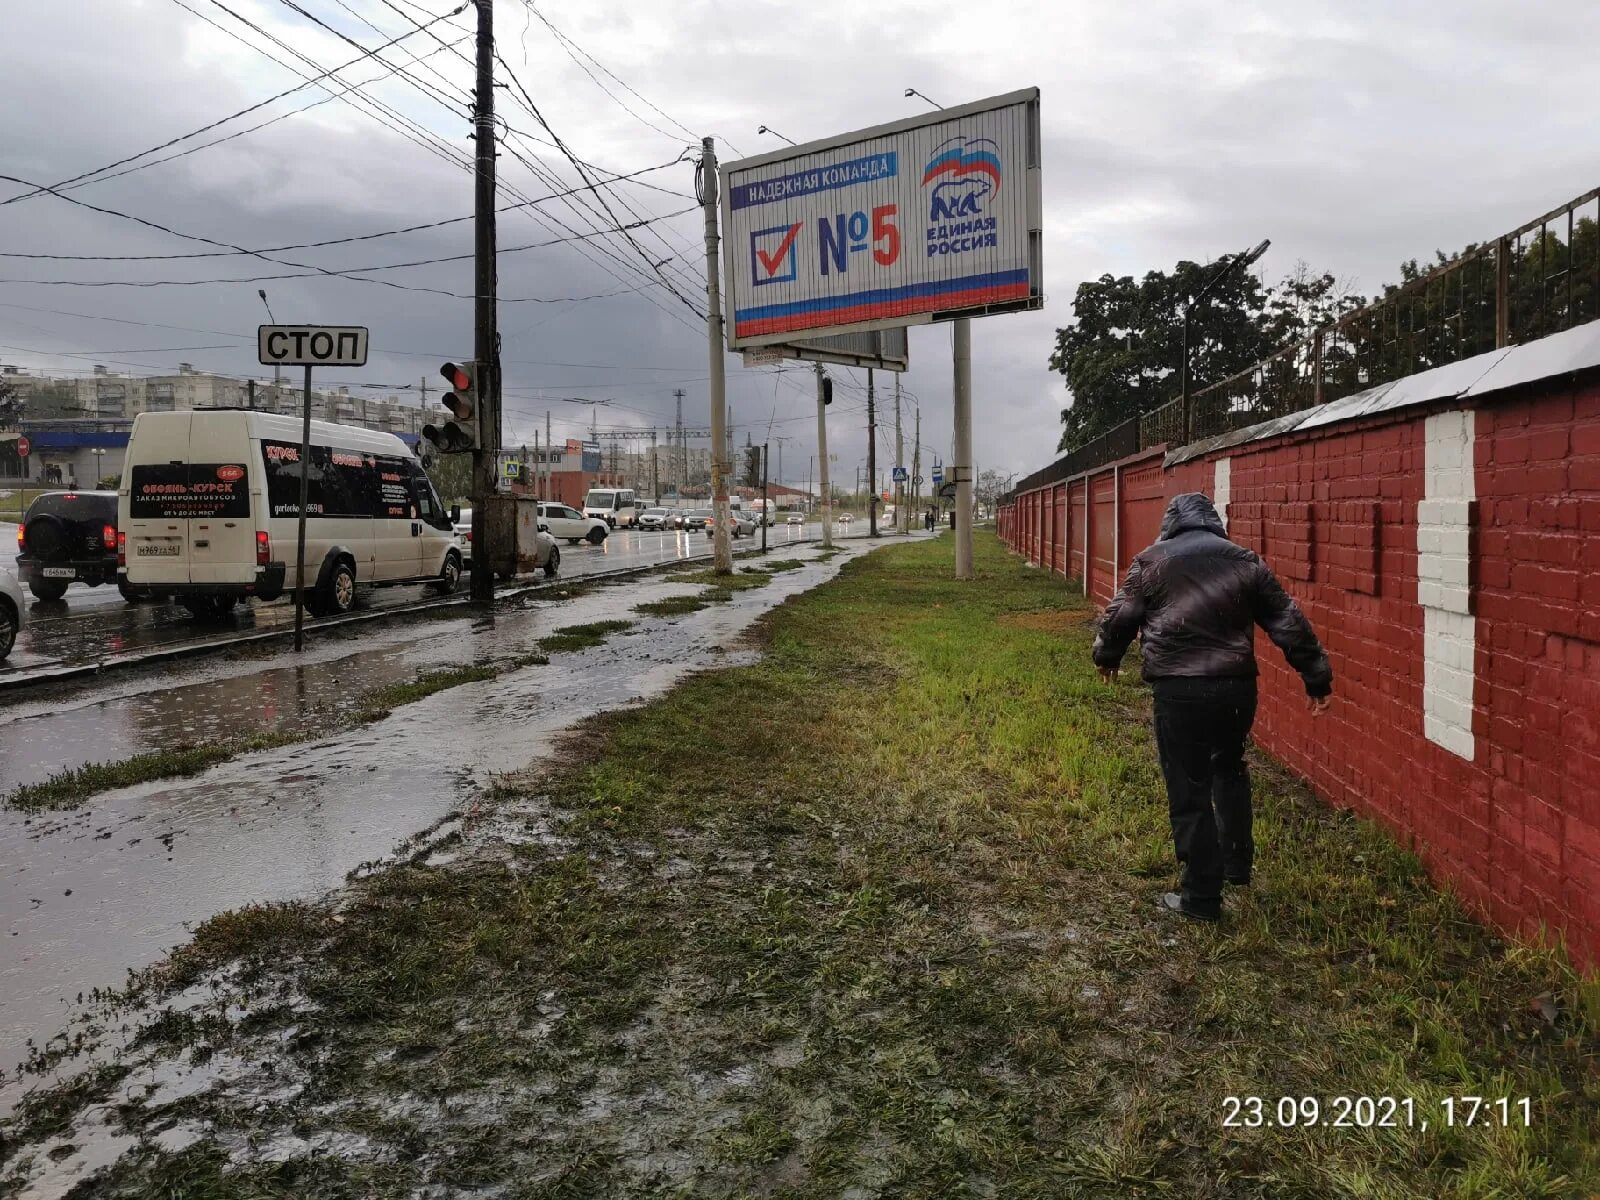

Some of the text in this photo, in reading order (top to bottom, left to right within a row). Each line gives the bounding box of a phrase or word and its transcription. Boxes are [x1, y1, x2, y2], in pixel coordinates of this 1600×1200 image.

[750, 158, 888, 201] НАДЕЖНАЯ КОМАНДА
[927, 217, 996, 240] ЕДИНАЯ
[927, 233, 997, 257] РОССИЯ
[267, 331, 359, 360] СТОП
